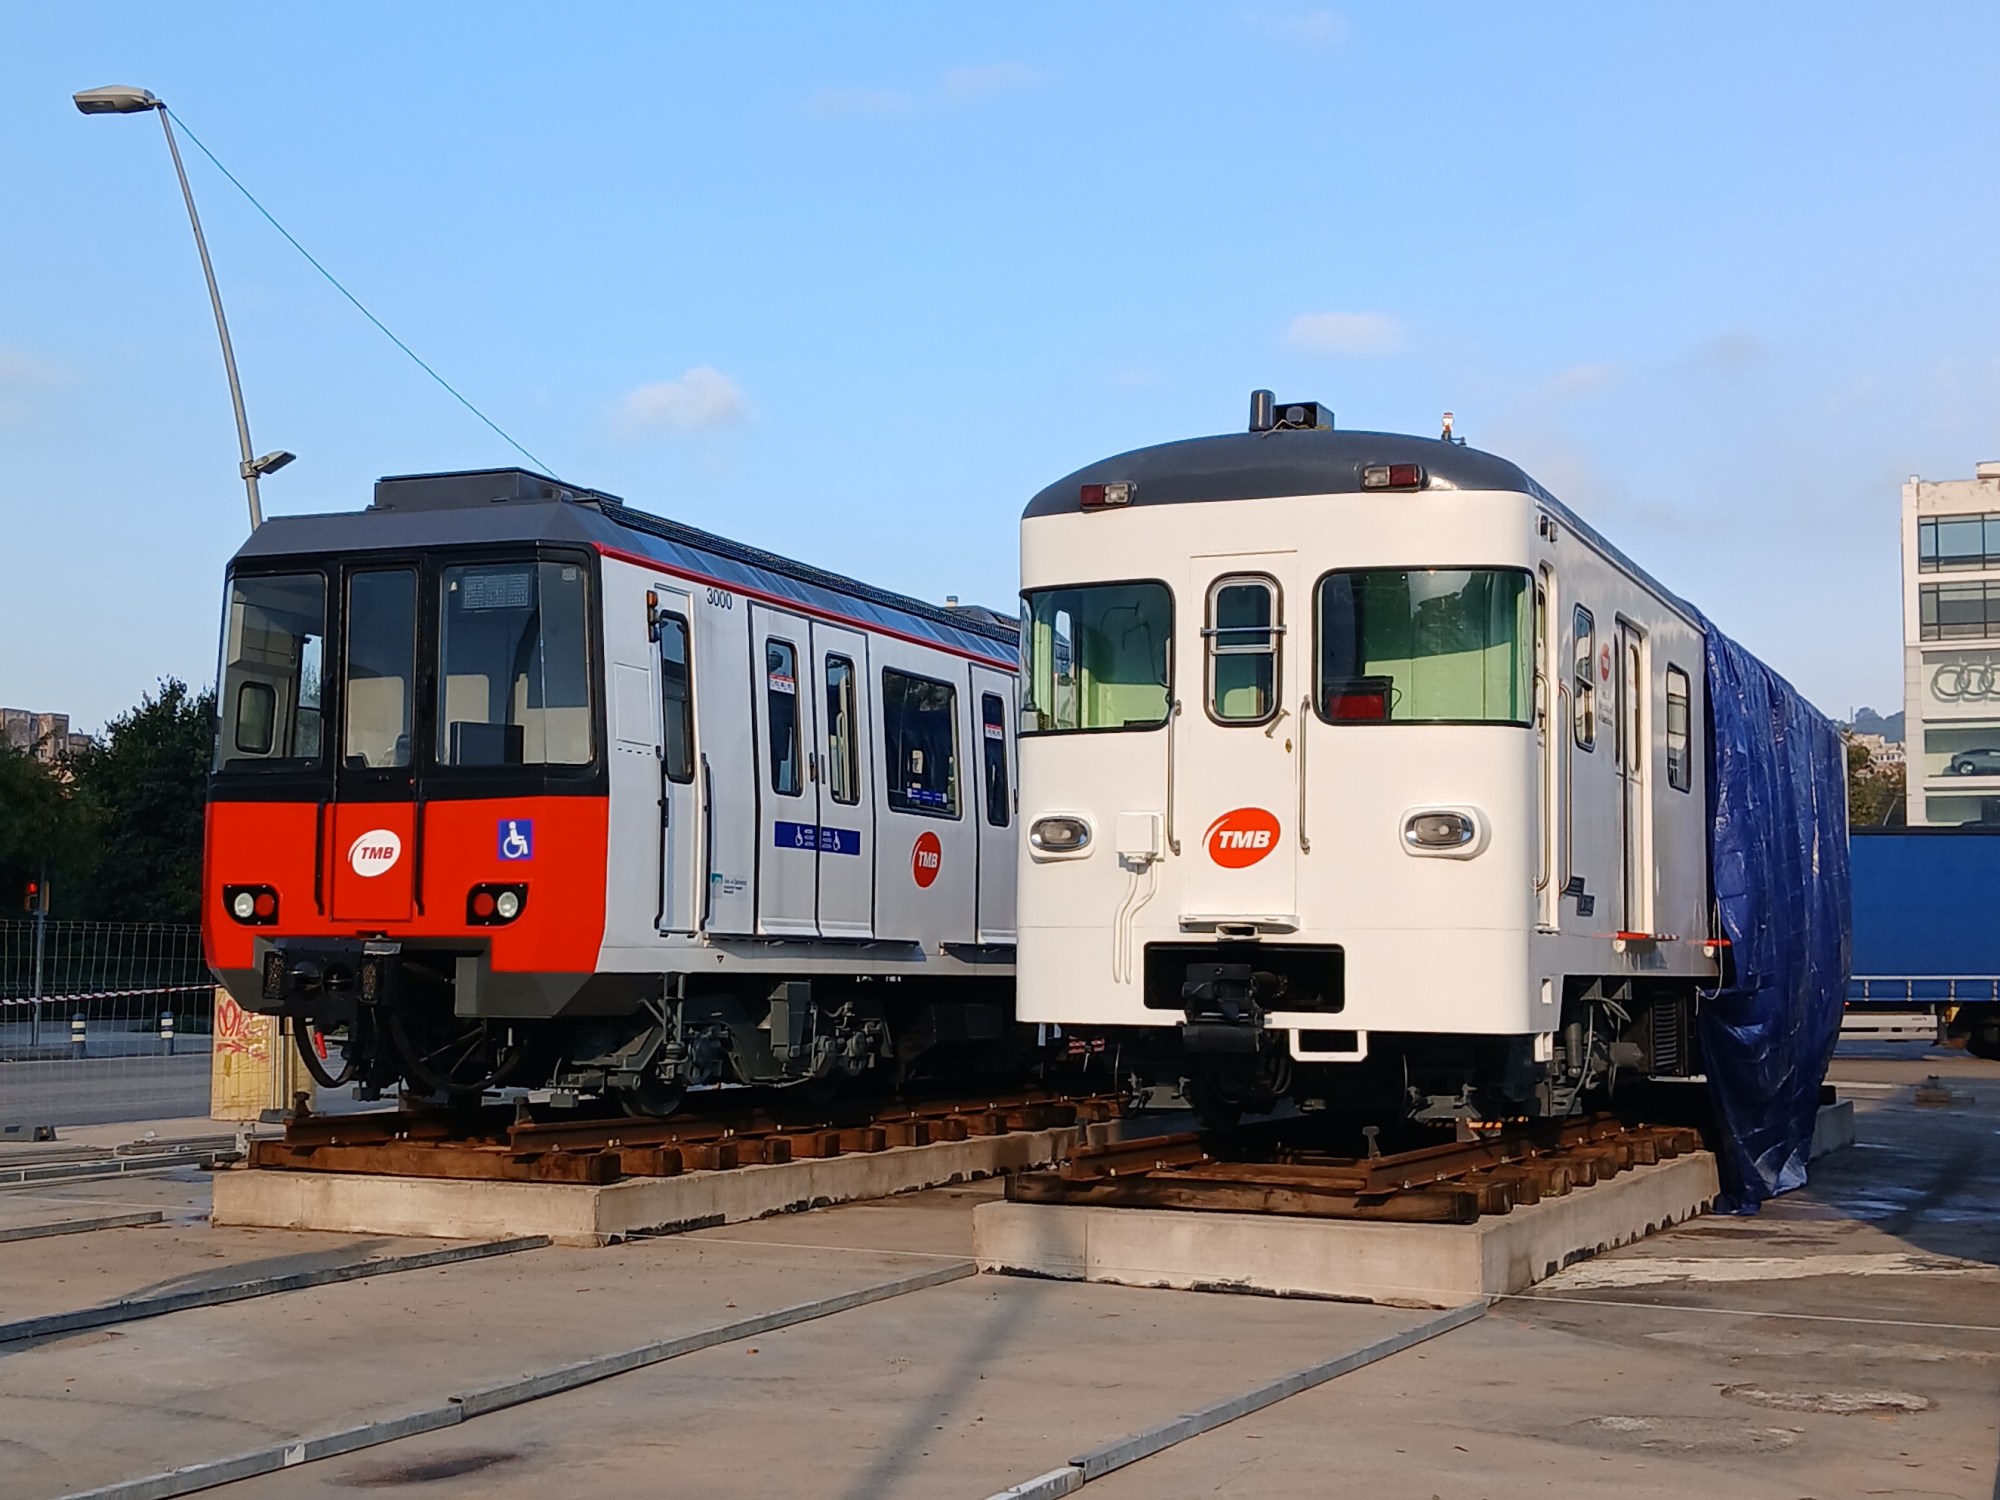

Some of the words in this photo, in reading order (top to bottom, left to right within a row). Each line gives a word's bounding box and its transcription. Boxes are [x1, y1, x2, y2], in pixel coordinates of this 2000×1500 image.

[707, 587, 732, 610] 3000
[1219, 830, 1271, 849] TMB
[361, 846, 394, 860] TMB
[918, 850, 938, 868] TMB
